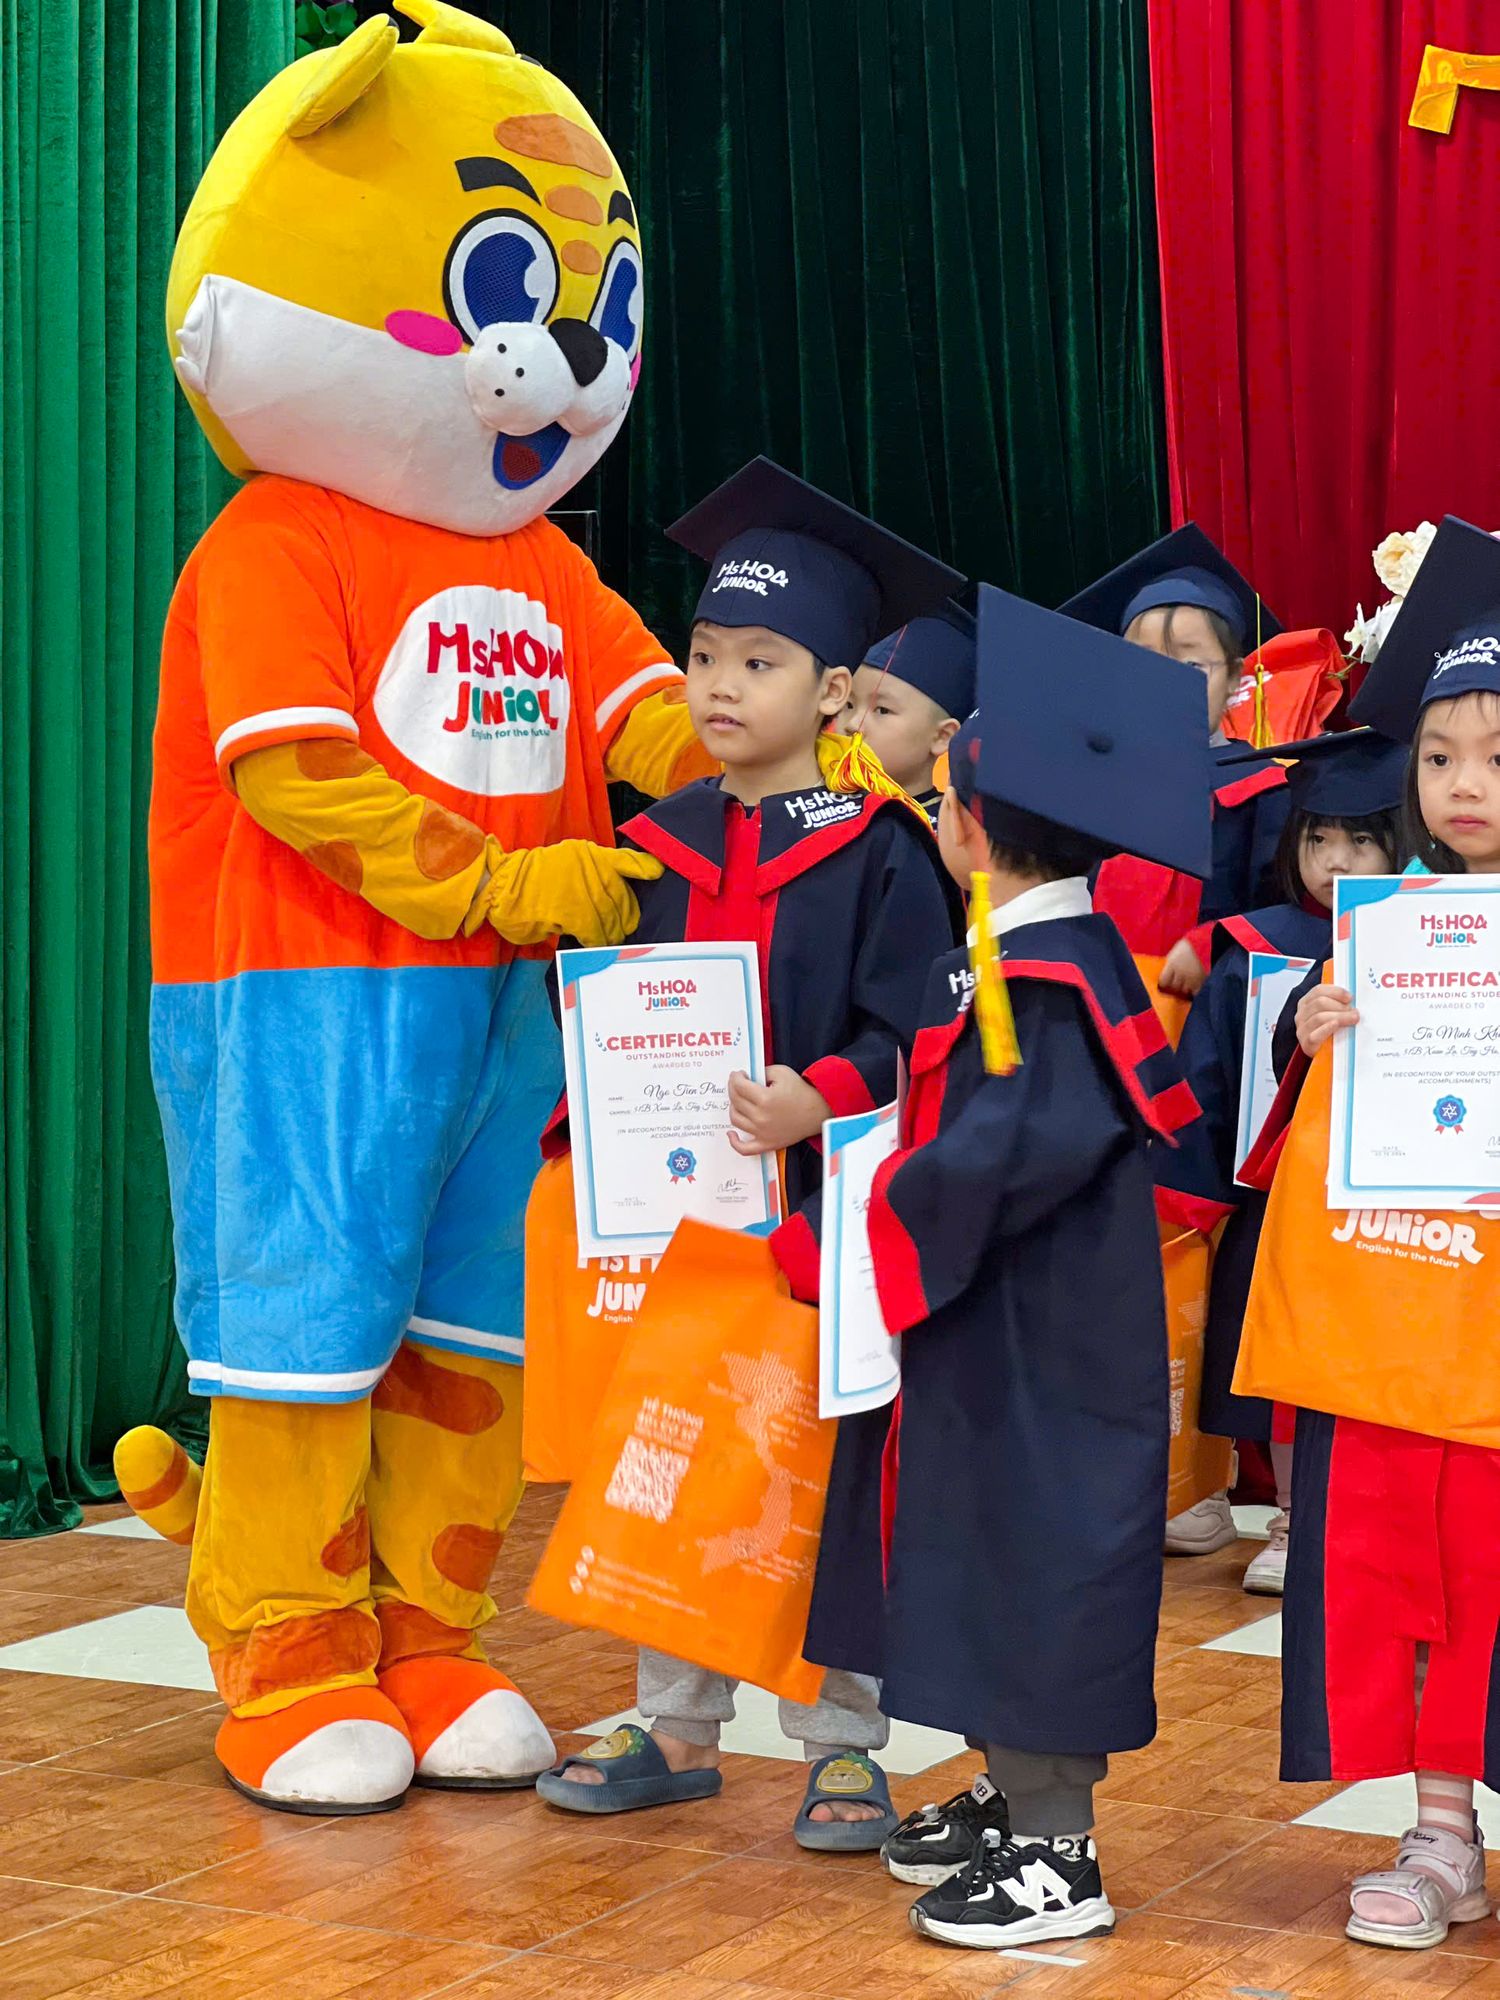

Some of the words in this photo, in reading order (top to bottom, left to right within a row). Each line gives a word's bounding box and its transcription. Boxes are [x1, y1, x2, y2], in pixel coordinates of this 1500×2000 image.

[494, 730, 511, 739] for
[513, 728, 530, 737] the
[1380, 971, 1500, 988] CERTIFICA
[1400, 991, 1468, 999] OUTSTANDING
[1428, 1002, 1472, 1010] AWARDED
[1474, 1002, 1486, 1010] TO
[606, 1031, 733, 1051] CERTIFICATE
[625, 1052, 687, 1061] OUTSTANDING
[689, 1050, 725, 1058] STUDENT
[1356, 1240, 1393, 1255] English
[1394, 1247, 1409, 1258] for
[1410, 1251, 1428, 1262] the
[1428, 1255, 1460, 1268] future
[586, 1277, 647, 1318] JUN
[604, 1313, 634, 1324] English
